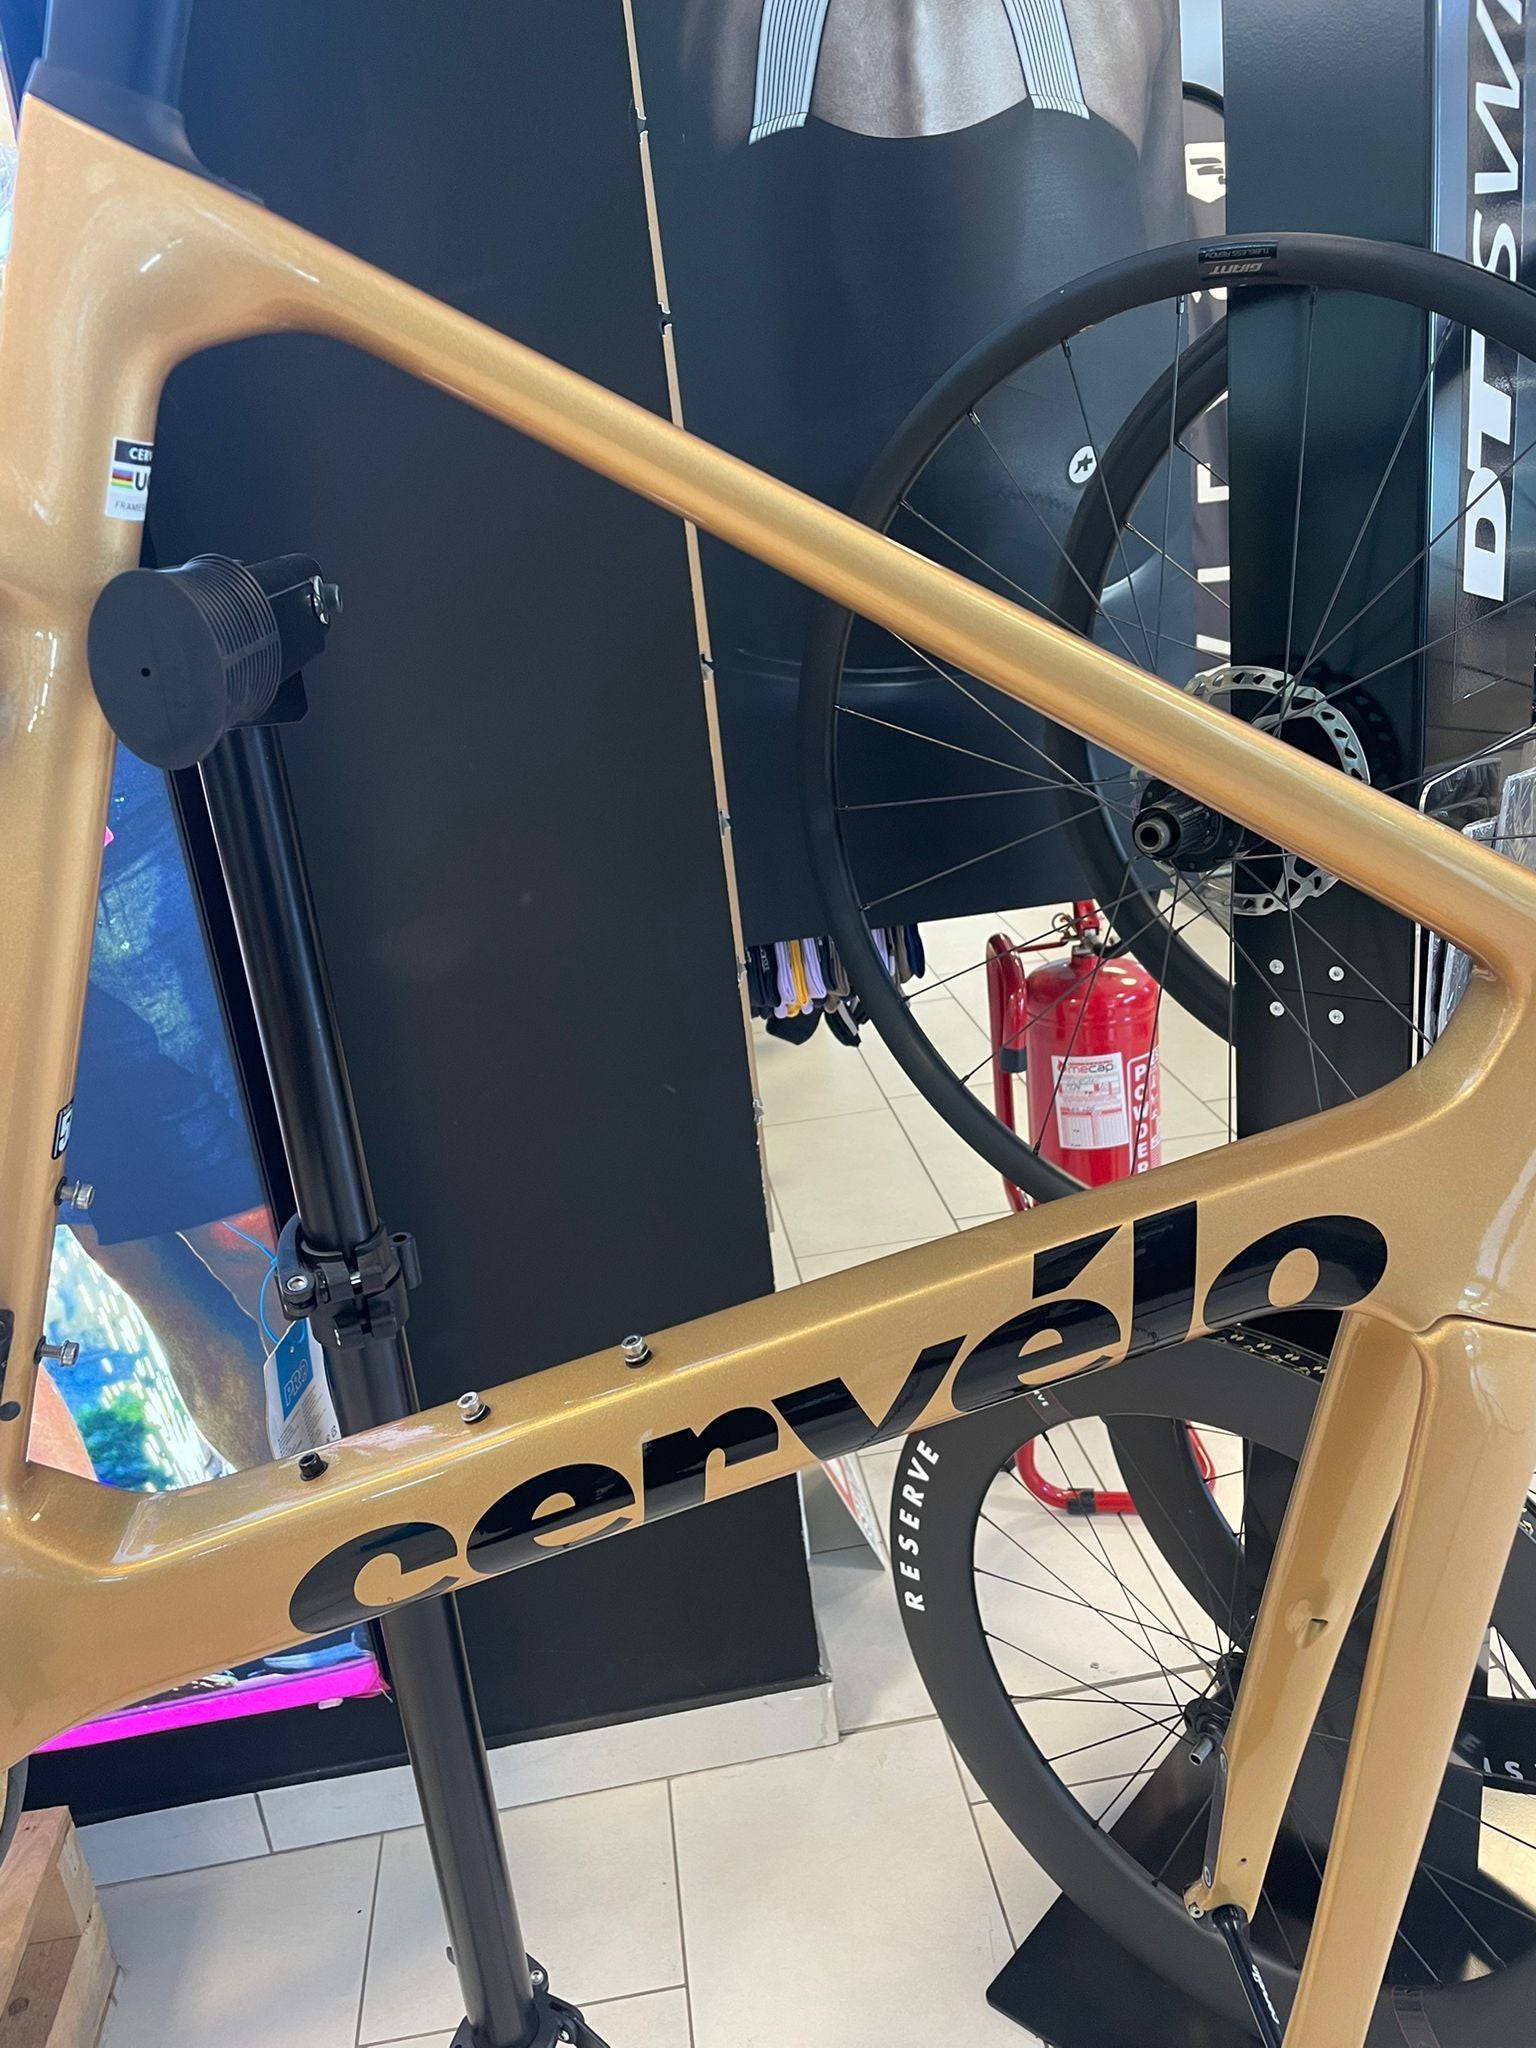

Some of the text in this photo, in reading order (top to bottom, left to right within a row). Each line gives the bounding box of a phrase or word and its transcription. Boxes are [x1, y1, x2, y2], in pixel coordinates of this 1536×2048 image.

[1207, 262, 1264, 276] GIANT
[1463, 0, 1524, 602] DT SW
[135, 471, 150, 491] U
[283, 1358, 309, 1407] PRO
[289, 1200, 1388, 1634] cervélo
[897, 1440, 940, 1612] RESERVE
